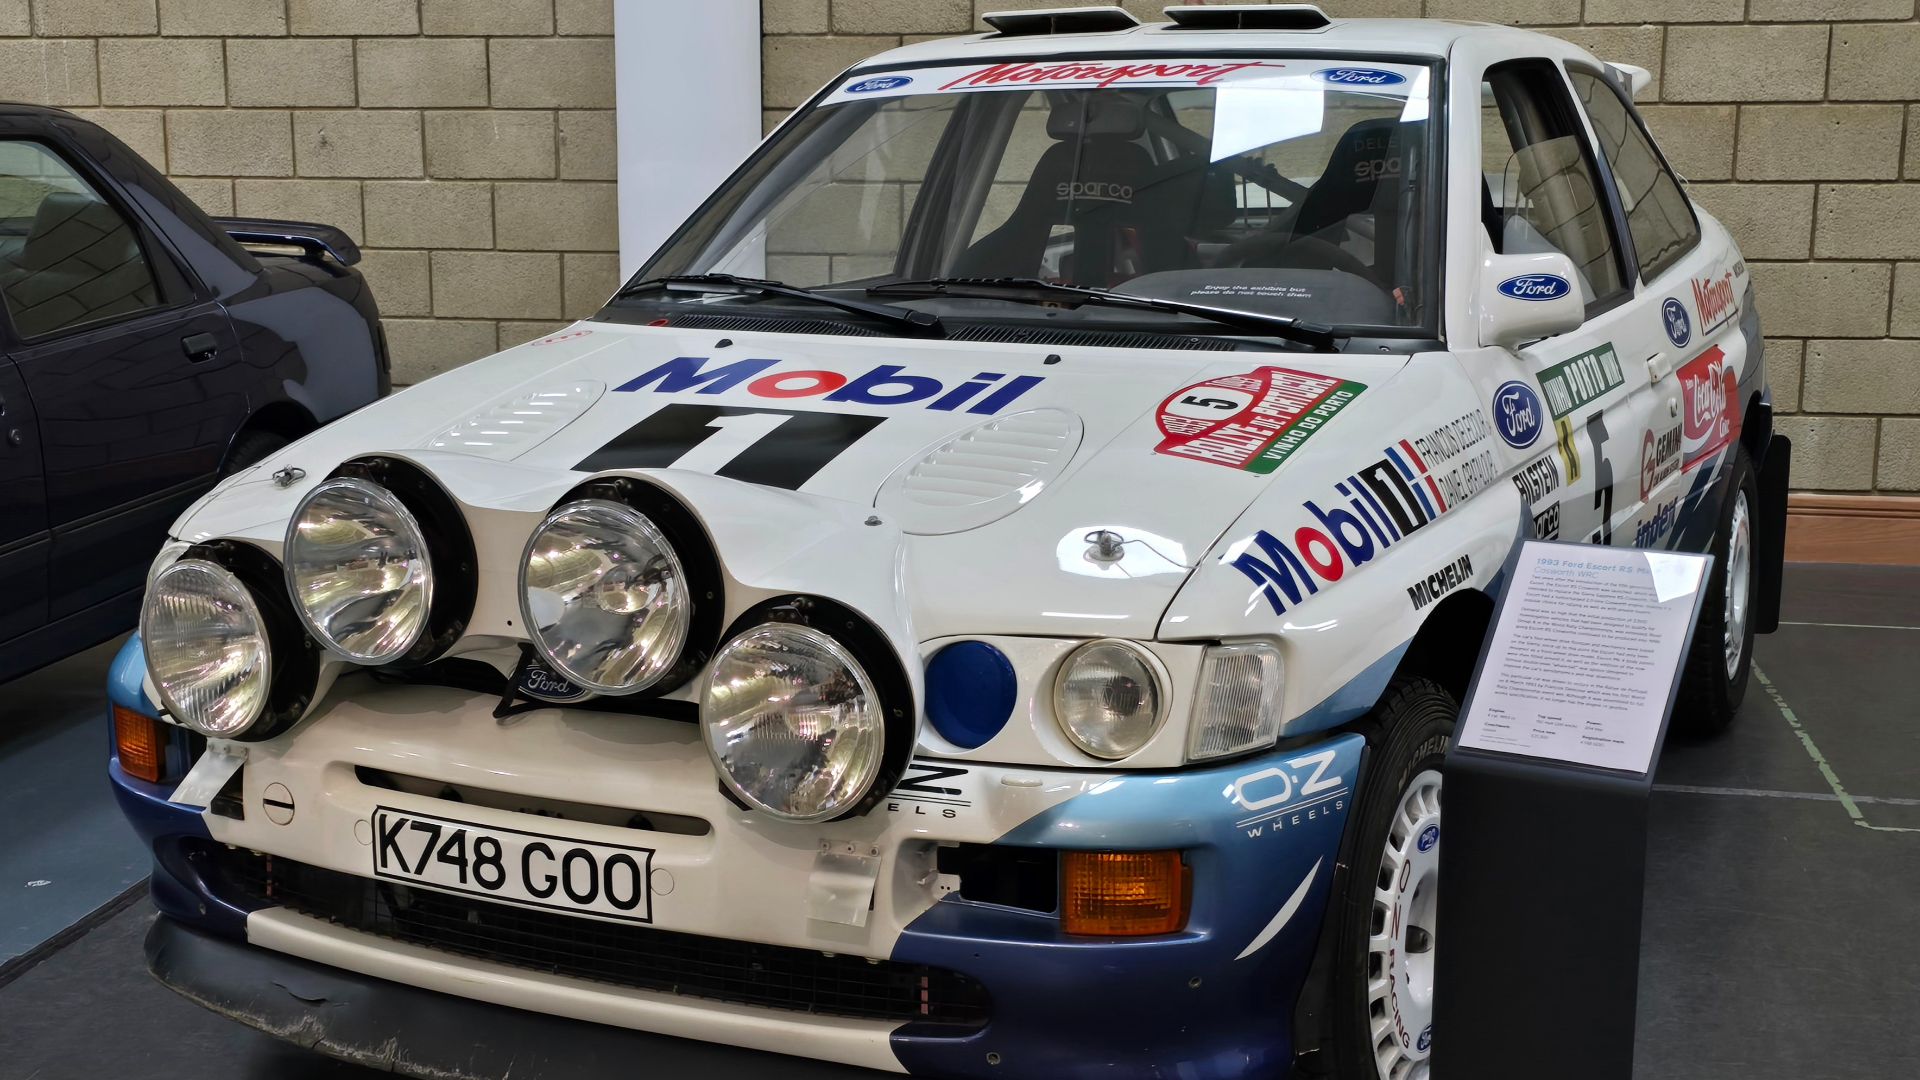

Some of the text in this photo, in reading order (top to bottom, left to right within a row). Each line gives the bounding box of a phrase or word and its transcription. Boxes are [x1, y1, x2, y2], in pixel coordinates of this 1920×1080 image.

[937, 62, 1285, 89] Motorsport
[1354, 157, 1401, 180] spa
[1056, 181, 1133, 200] sparco
[1513, 278, 1557, 295] Ford
[611, 356, 1046, 415] Mobil
[1249, 369, 1338, 419] PORTUGAL
[1562, 353, 1606, 405] PORTO
[1180, 395, 1239, 410] 5
[1248, 415, 1287, 429] DE
[1502, 391, 1536, 437] Ford
[1168, 422, 1274, 463] RALLYE
[1261, 390, 1354, 459] VINHO DO PORTO
[1512, 454, 1560, 506] BILSTEIN
[1536, 505, 1559, 539] arco
[1230, 475, 1401, 616] Mobil
[1537, 558, 1560, 567] 1993
[1561, 560, 1583, 569] Ford
[1586, 562, 1616, 572] Escort
[1406, 553, 1474, 611] MICHELIN
[528, 669, 571, 693] Ford
[896, 763, 969, 795] Z
[887, 803, 957, 819] ELS
[1247, 800, 1343, 839] WHEELS
[378, 813, 642, 911] K748 GOO
[1389, 948, 1411, 1049] RACING
